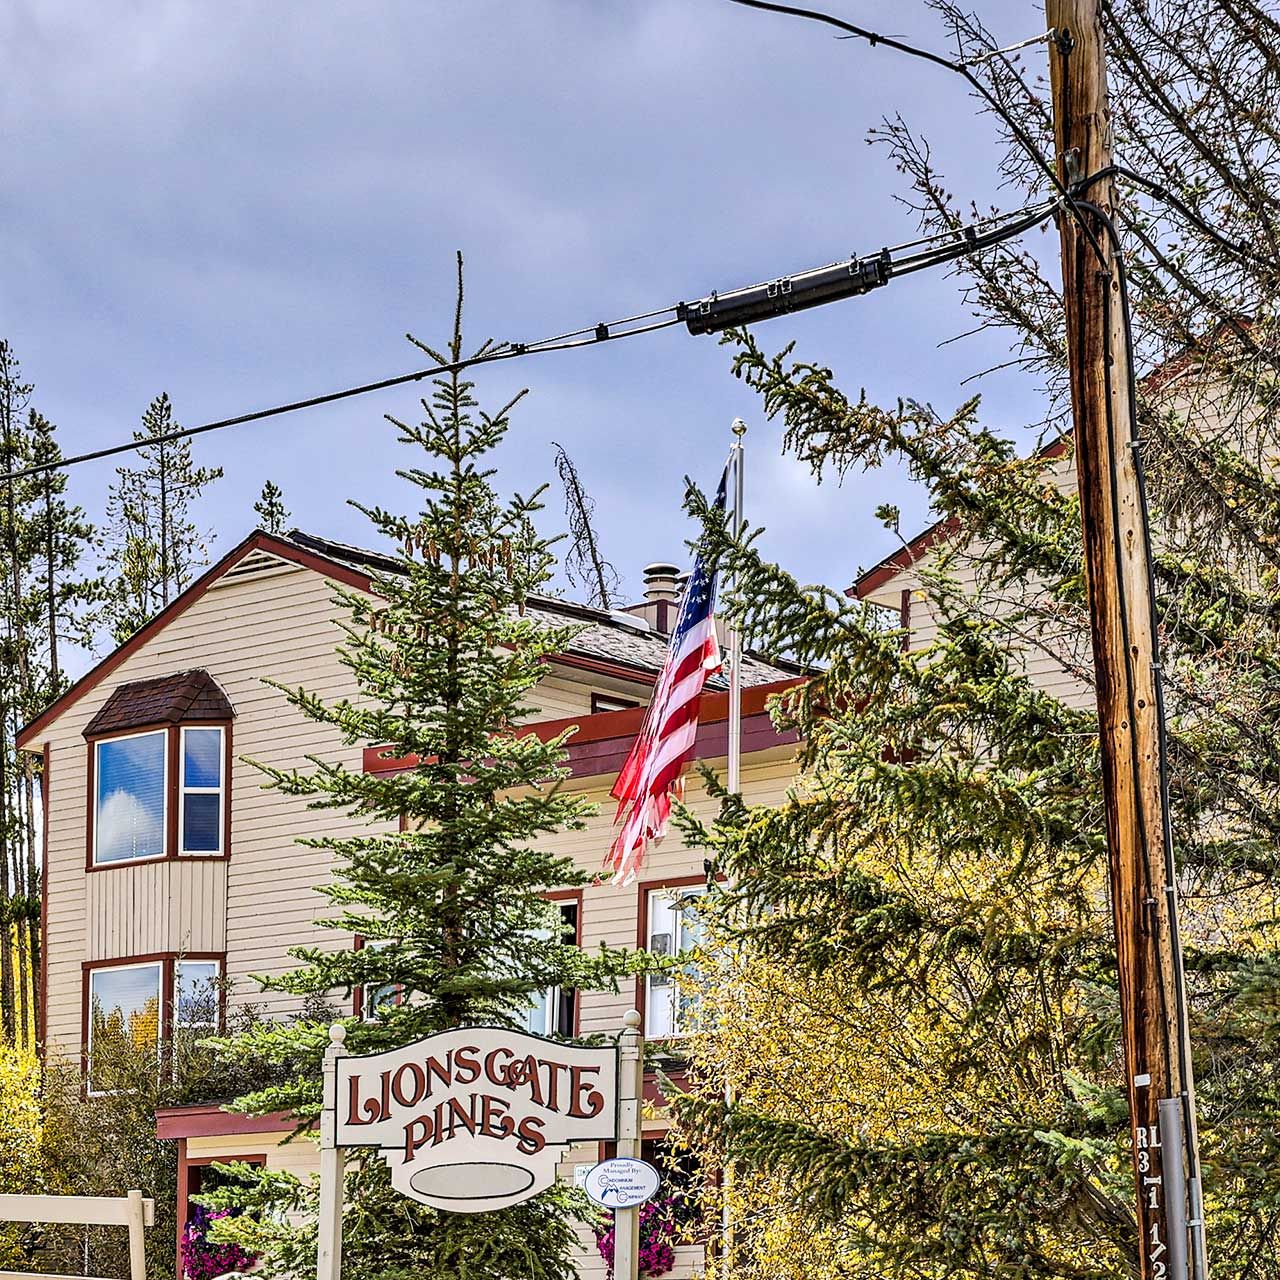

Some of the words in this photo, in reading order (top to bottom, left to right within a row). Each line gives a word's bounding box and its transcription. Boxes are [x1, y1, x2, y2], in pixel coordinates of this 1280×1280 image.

[344, 1045, 605, 1126] LIONSGATE
[402, 1093, 546, 1165] PINES
[1136, 1125, 1162, 1149] RL
